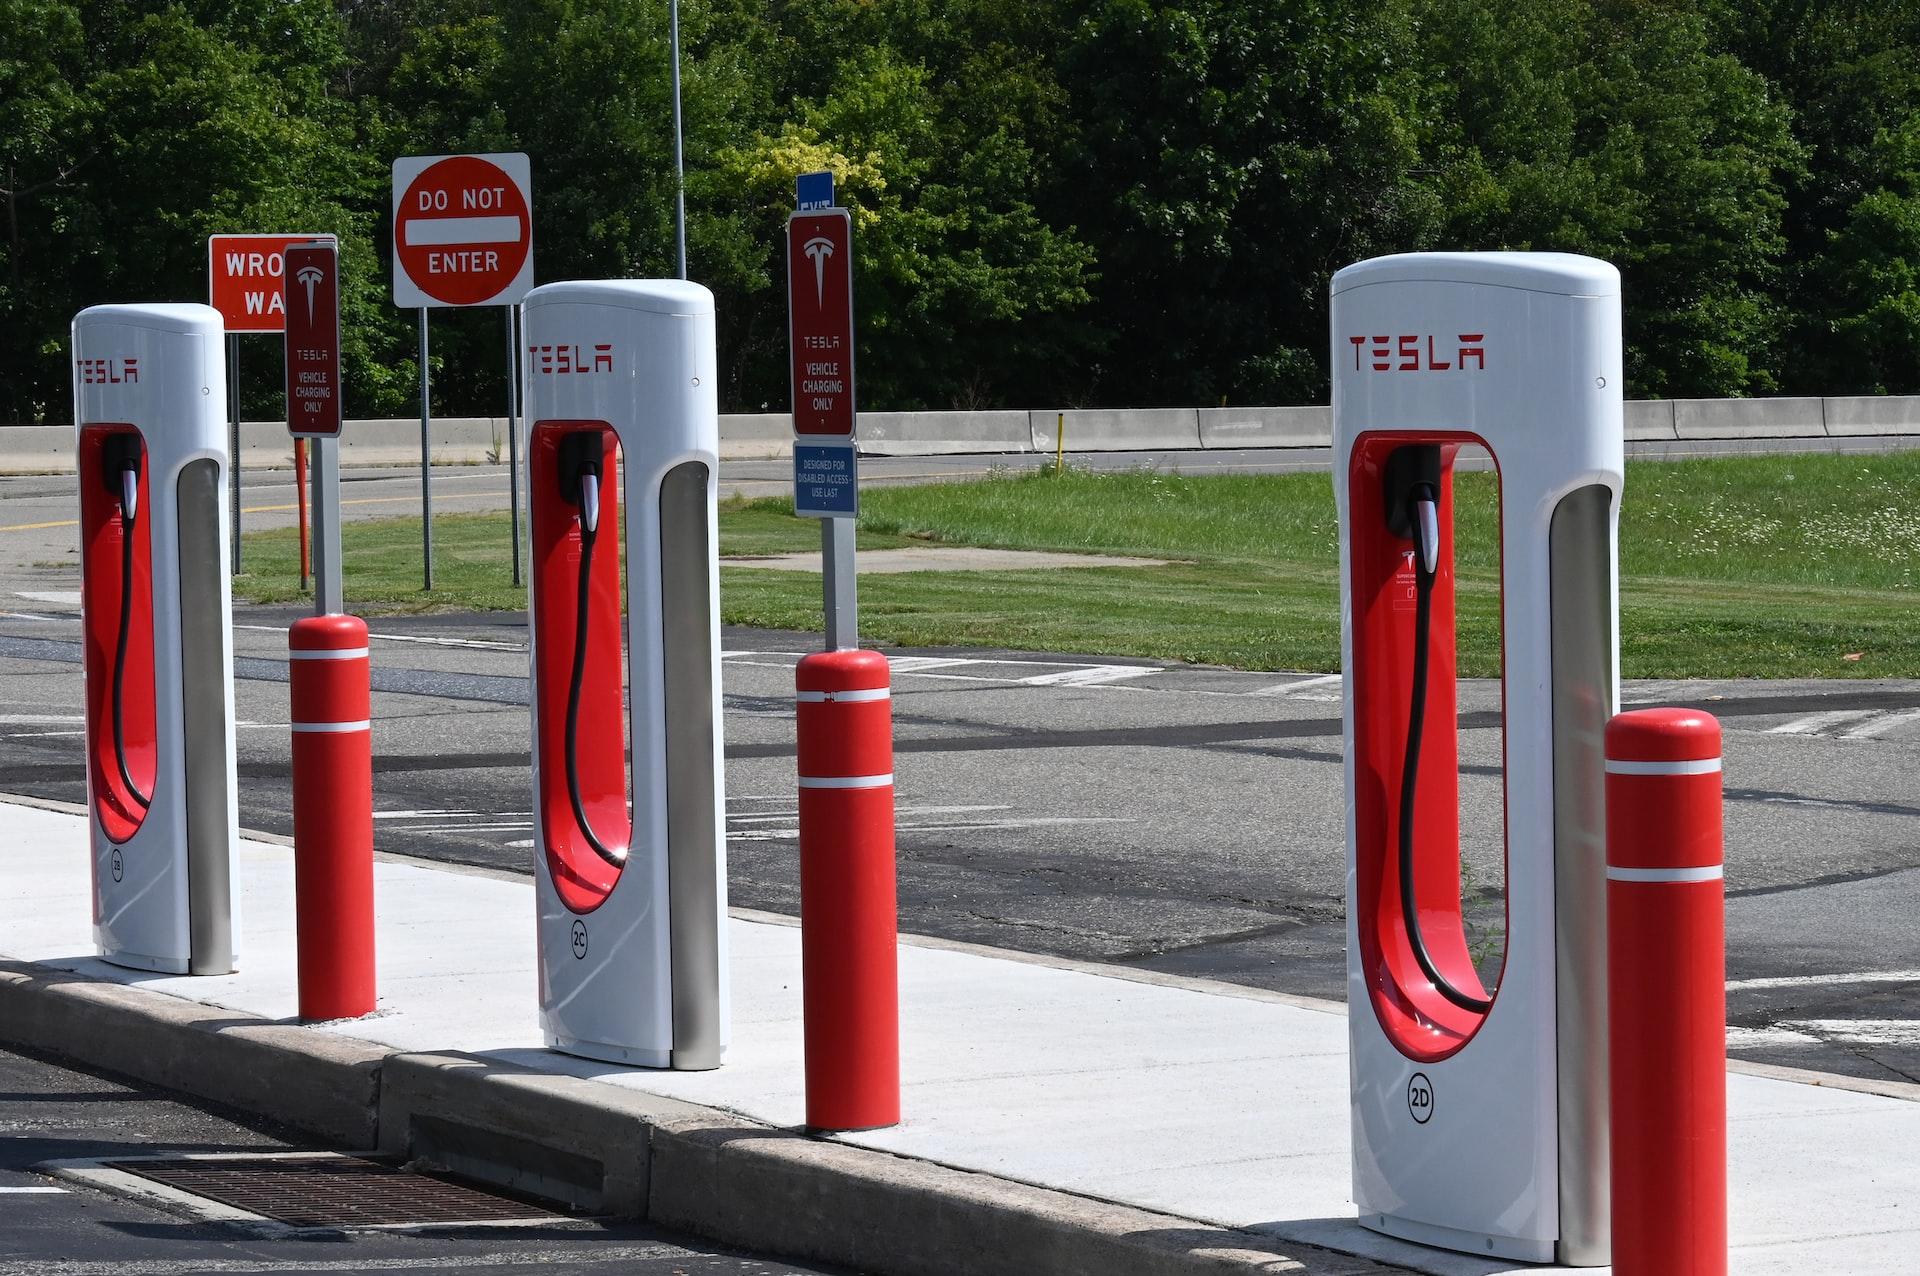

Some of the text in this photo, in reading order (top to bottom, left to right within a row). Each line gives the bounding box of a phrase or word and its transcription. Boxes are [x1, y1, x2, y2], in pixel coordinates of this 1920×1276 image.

[419, 187, 505, 211] DO NOT
[225, 252, 284, 277] WRO
[428, 251, 499, 273] ENTER
[244, 291, 285, 315] WA
[804, 335, 840, 349] TESLA
[296, 349, 328, 361] TESLA
[528, 344, 612, 374] TESLA
[1349, 334, 1484, 371] TESLA
[76, 359, 138, 384] TESLA
[806, 362, 839, 376] VEHICLE
[298, 371, 327, 383] VEHICLE
[295, 386, 331, 399] CHARGING
[802, 380, 843, 393] CHARGING
[303, 401, 323, 413] ONLY
[812, 397, 833, 411] ONLY
[803, 459, 845, 471] DESIGNED FOR
[797, 473, 826, 484] DISABLED
[826, 474, 849, 485] ACCESS
[811, 487, 839, 499] USE LAST
[574, 931, 585, 947] 2C
[1411, 1087, 1430, 1108] 2D
